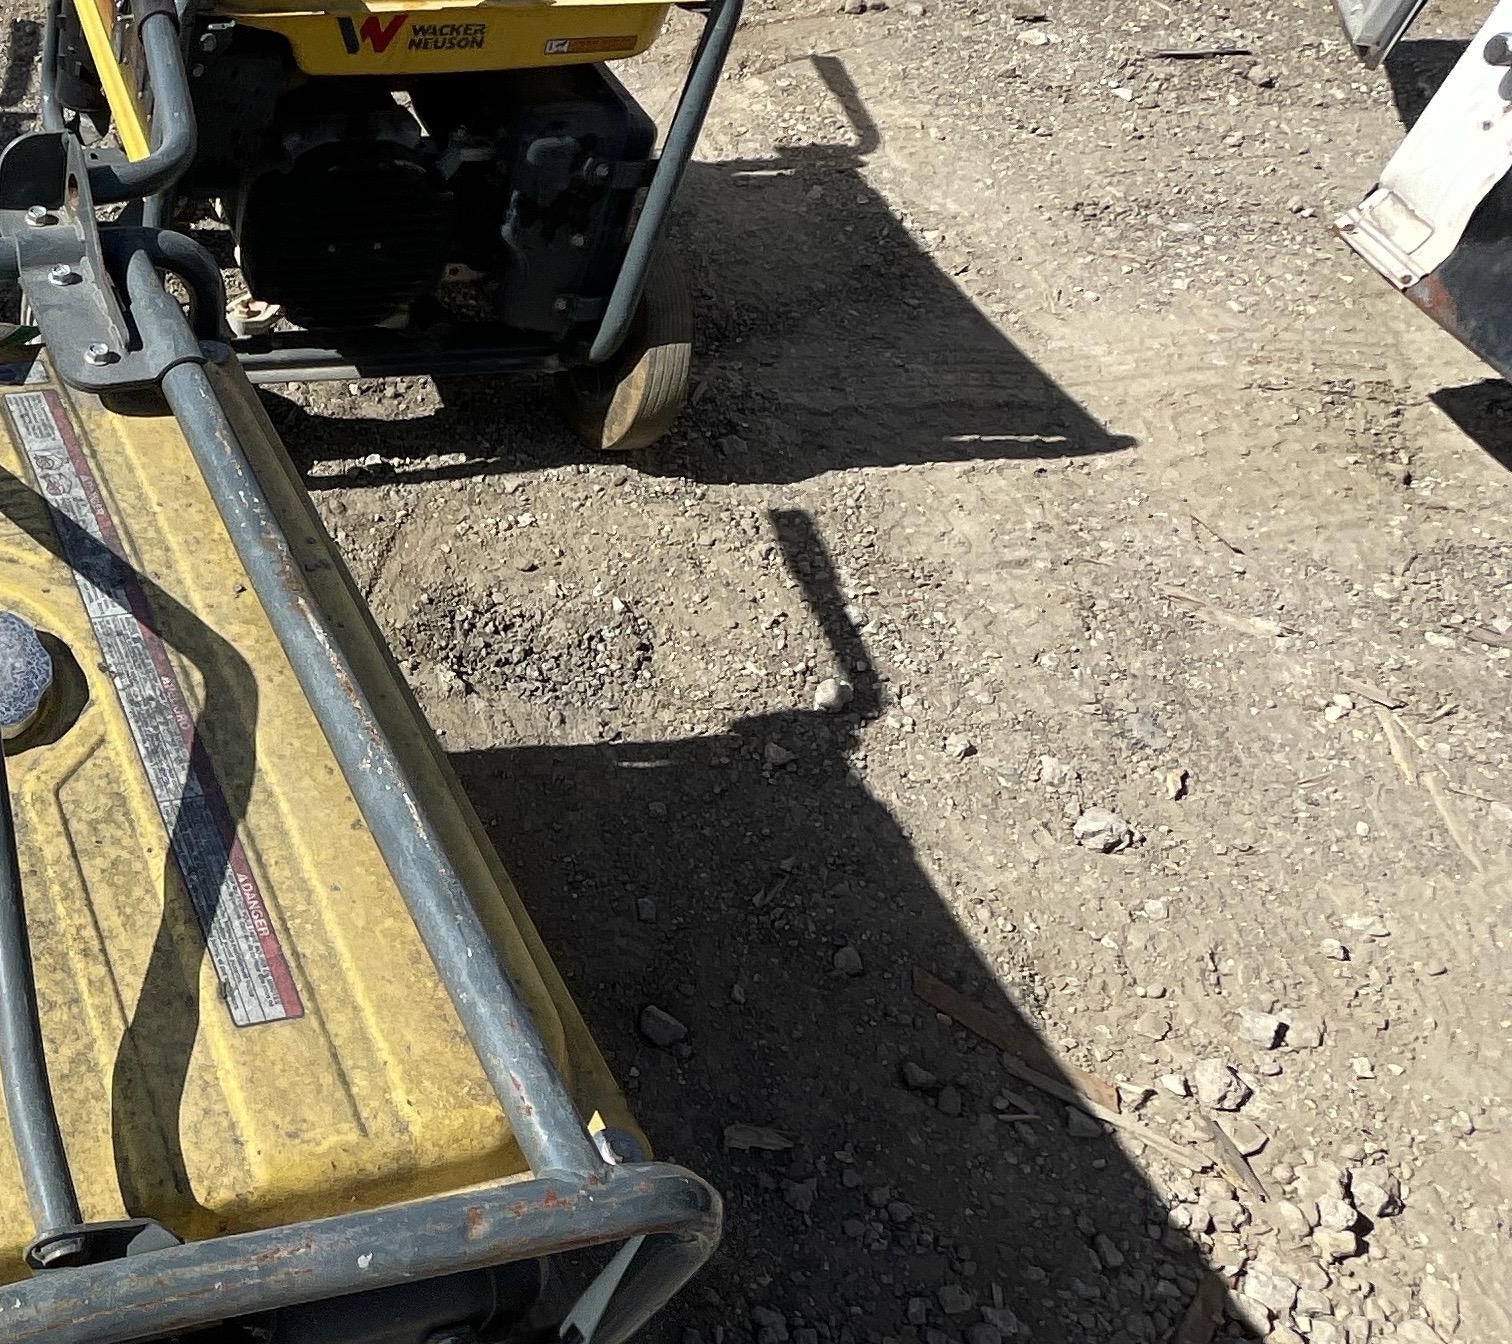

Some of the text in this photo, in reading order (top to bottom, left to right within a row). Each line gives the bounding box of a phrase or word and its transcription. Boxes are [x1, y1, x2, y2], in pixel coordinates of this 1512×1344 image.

[411, 23, 487, 36] WACKER
[408, 36, 485, 51] NEUSON
[241, 881, 270, 936] DANGER
